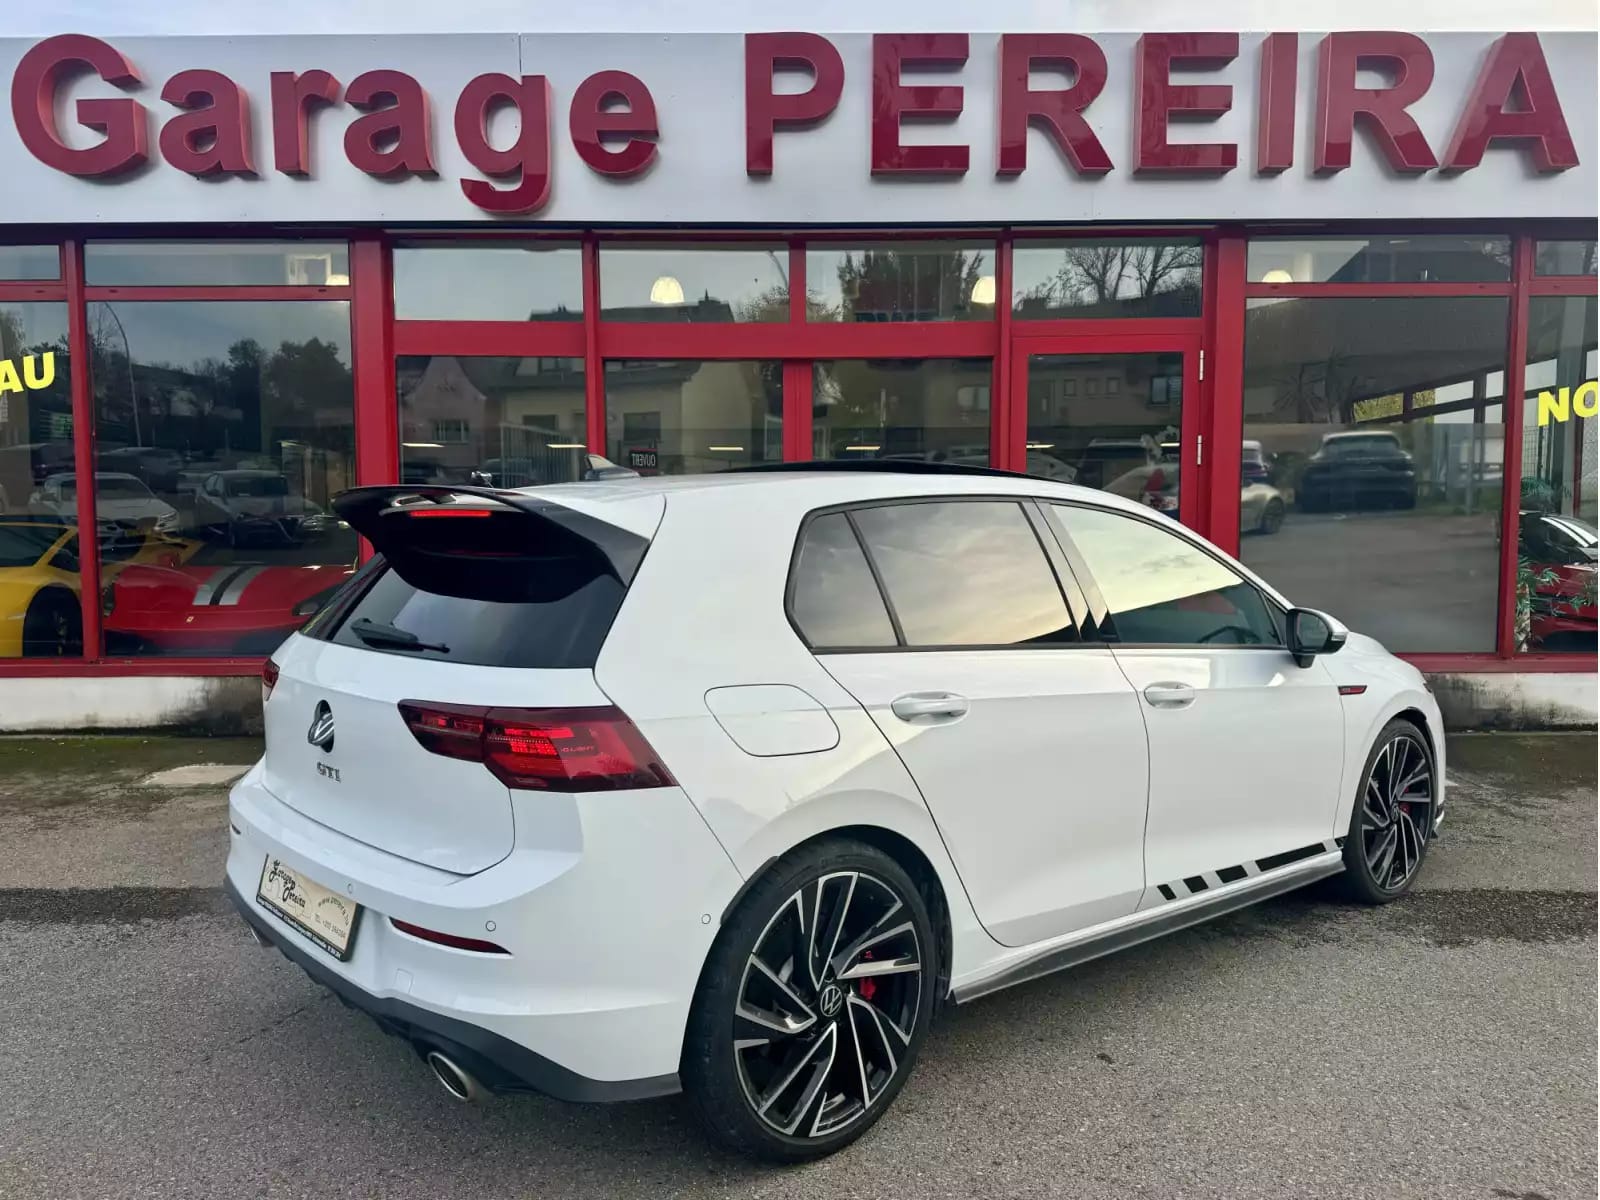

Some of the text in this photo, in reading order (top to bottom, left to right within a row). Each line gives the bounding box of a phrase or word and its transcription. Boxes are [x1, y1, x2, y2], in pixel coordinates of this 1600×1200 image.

[11, 32, 1580, 215] Garage PEREIRA
[316, 761, 342, 783] GTI
